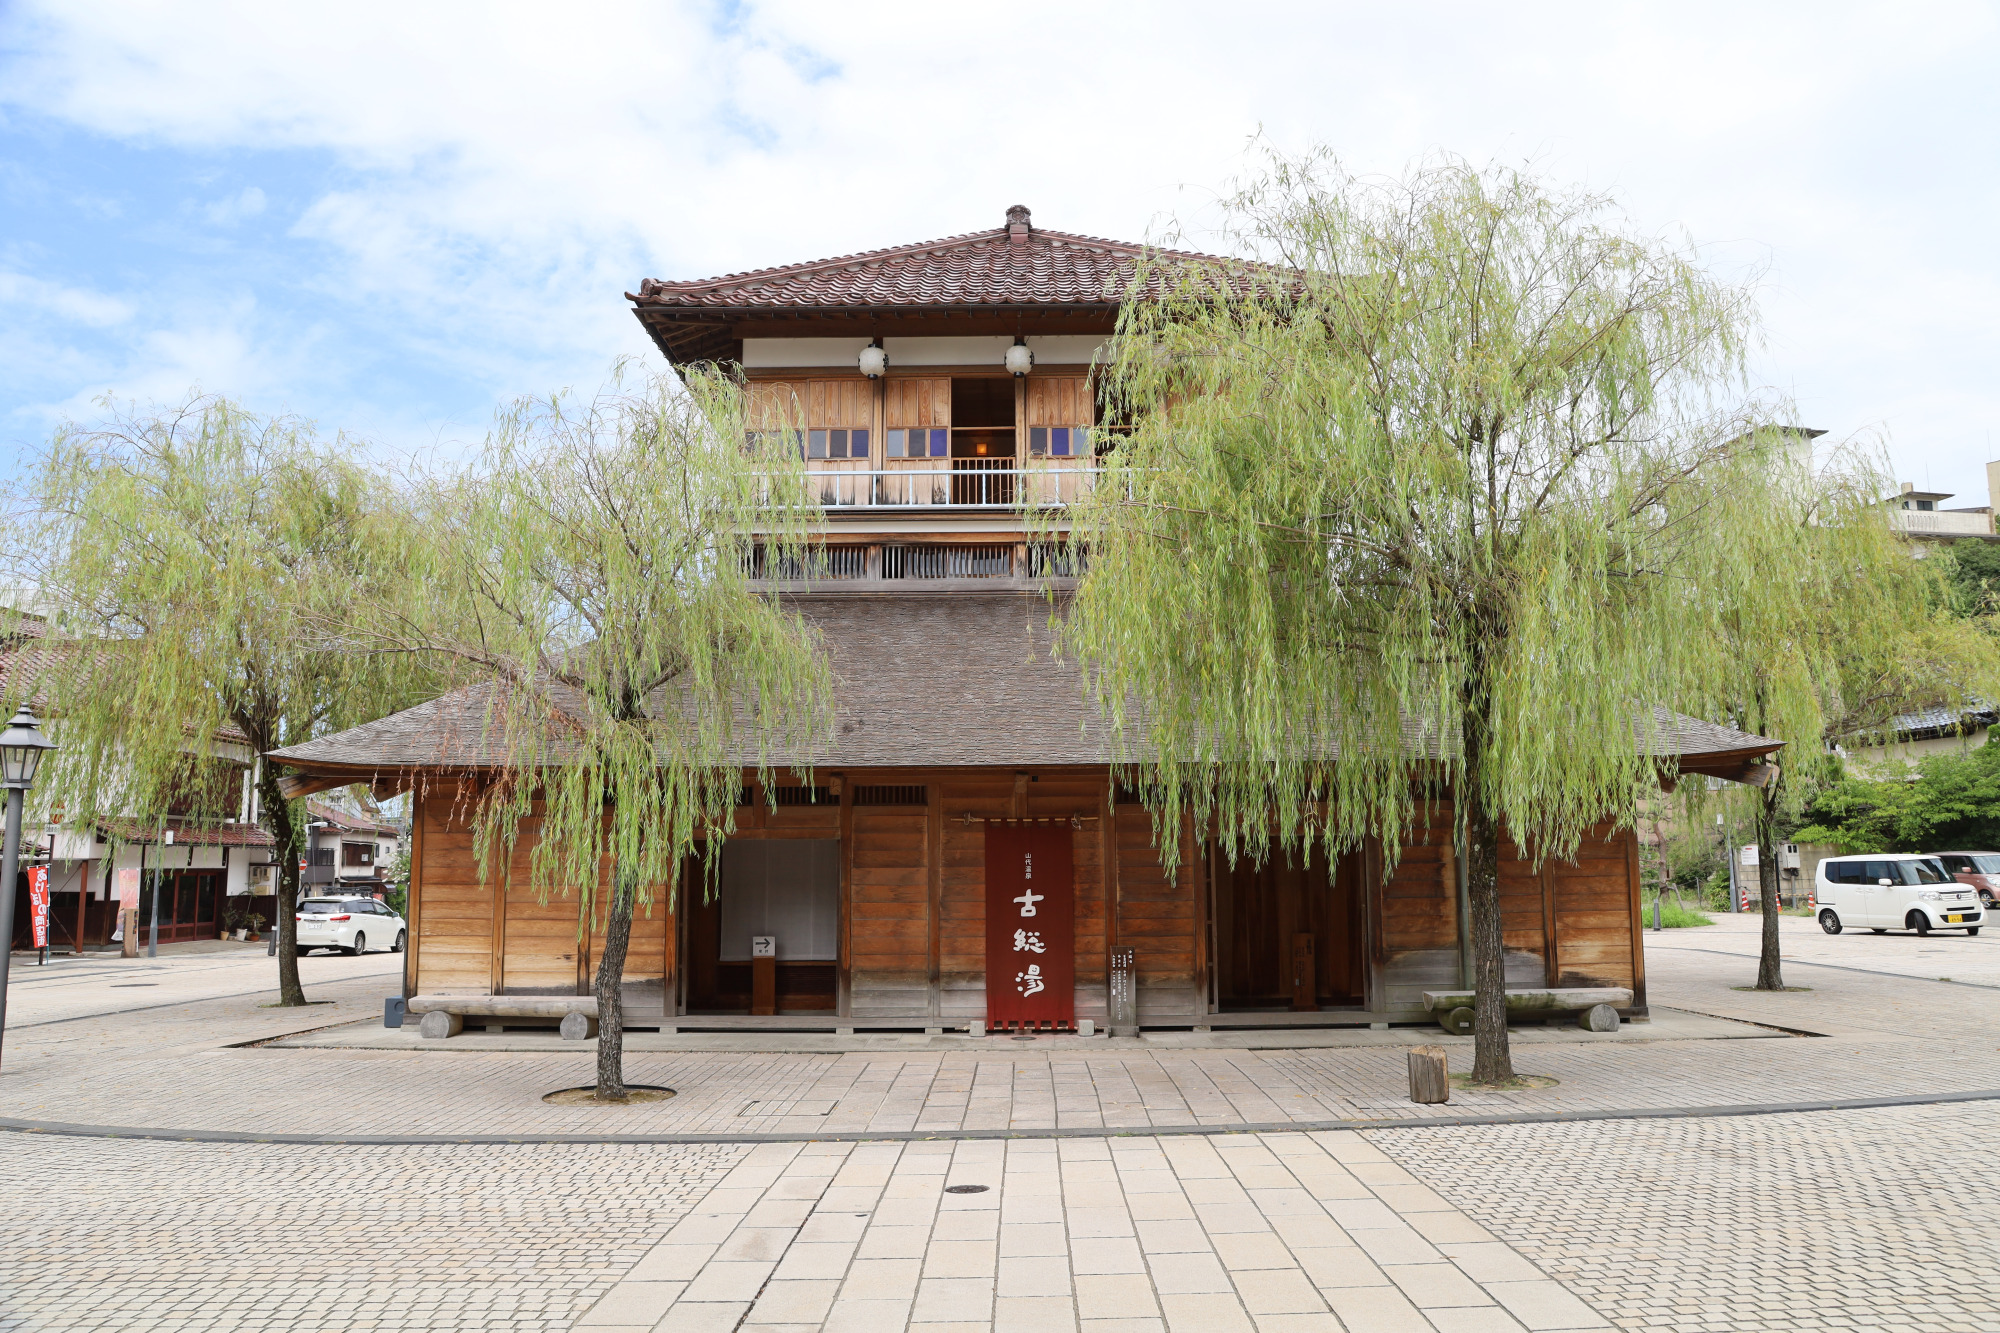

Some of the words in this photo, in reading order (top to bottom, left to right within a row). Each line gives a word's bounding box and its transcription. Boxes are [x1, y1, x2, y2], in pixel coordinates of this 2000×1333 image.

[30, 868, 47, 947] あけぼの商店街
[1013, 888, 1046, 998] 古総湯
